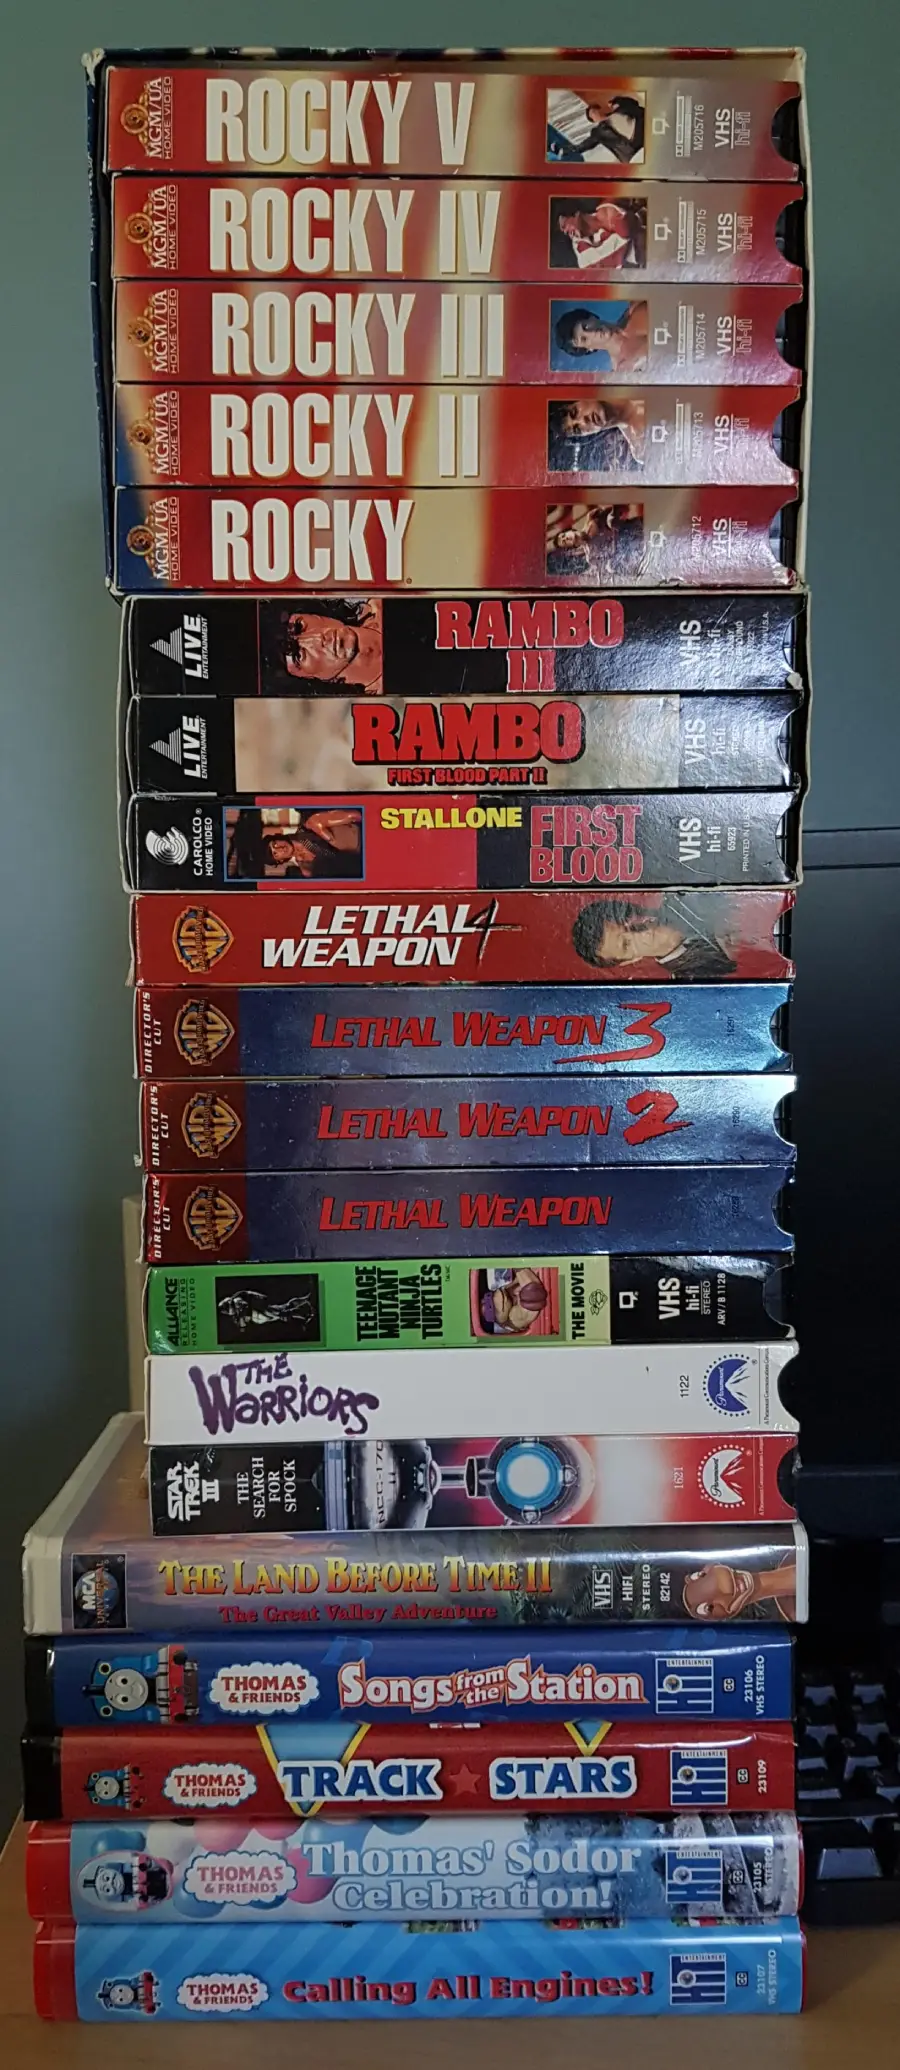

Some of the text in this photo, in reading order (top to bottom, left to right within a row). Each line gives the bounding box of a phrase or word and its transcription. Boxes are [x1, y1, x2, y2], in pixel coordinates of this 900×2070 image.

[147, 77, 162, 158] MGM/UA
[164, 76, 173, 159] HOME VIDEO
[206, 78, 475, 165] ROCKY V
[694, 104, 705, 151] M205716
[715, 108, 730, 148] VHS
[152, 186, 167, 268] MGM/UA
[168, 184, 179, 270] HOME VIDEO
[209, 187, 501, 274] ROCKY IV
[696, 209, 707, 256] M205715
[717, 212, 733, 252] VHS
[152, 289, 168, 372] MGM/UA
[168, 288, 179, 373] HOME VIDEO
[212, 291, 504, 378] ROCKY III
[717, 316, 732, 356] VHS
[154, 392, 168, 475] MGM/UA
[170, 391, 179, 476] HOME VIDEO
[211, 392, 480, 478] ROCKY II
[714, 415, 730, 455] VHS
[155, 498, 168, 580] MGM/UA
[170, 496, 179, 580] HOME VIDEO
[212, 498, 415, 583] ROCKY
[712, 519, 728, 558] VHS
[434, 599, 624, 650] RAMBO
[680, 620, 702, 666] VHS
[184, 615, 202, 678] LIVE
[506, 649, 556, 692] III
[183, 715, 201, 778] LIVE
[350, 701, 586, 765] RAMBO
[684, 718, 706, 764] VHS
[387, 767, 548, 786] FIRST BLOOD PART II
[381, 807, 522, 829] STALLONE
[530, 805, 643, 846] FIRST
[193, 817, 203, 876] CAROLCO
[205, 817, 213, 876] HOME VIDEO
[679, 817, 702, 862] VHS
[707, 826, 721, 853] hi-fi
[727, 827, 736, 852] 65923
[742, 829, 750, 872] PRINTED IN
[530, 847, 644, 884] BLOOD
[304, 904, 480, 936] LETHAL
[263, 936, 463, 968] WEAPON
[143, 992, 153, 1074] DIRECTOR'S
[154, 1020, 162, 1045] CUT
[310, 1002, 671, 1064] LETHAL WEAPON 3
[150, 1085, 160, 1166] DIRECTOR'S
[161, 1113, 169, 1138] CUT
[317, 1088, 694, 1146] LETHAL WEAPON 2
[152, 1179, 162, 1259] DIRECTOR'S
[320, 1193, 612, 1231] LETHAL WEAPON
[355, 1265, 378, 1342] TEENAGE
[377, 1267, 400, 1339] MUTANT
[399, 1275, 422, 1329] NINJA
[421, 1264, 443, 1340] TURTLES
[571, 1263, 585, 1341] THE MOVIE
[658, 1277, 680, 1319] VHS
[685, 1285, 700, 1311] hi-fi
[703, 1281, 711, 1315] STEREO
[717, 1273, 726, 1294] 1128
[165, 1277, 178, 1346] ALLIANCE
[240, 1352, 292, 1384] THE
[680, 1375, 689, 1398] 1122
[714, 1366, 727, 1406] Paramount
[167, 1461, 184, 1521] STAR
[184, 1461, 201, 1521] TREK
[202, 1479, 219, 1502] III
[237, 1472, 249, 1504] THE
[252, 1457, 265, 1519] SEARCH
[268, 1470, 280, 1502] FOR
[283, 1459, 296, 1512] SPOCK
[674, 1467, 683, 1489] 1621
[710, 1457, 723, 1497] Paramount
[82, 1573, 96, 1610] MCA
[160, 1556, 553, 1596] THE LAND BEFORE TIME II
[594, 1571, 611, 1607] VHS
[622, 1576, 633, 1601] HIFI
[642, 1564, 650, 1611] STEREO
[660, 1572, 670, 1602] 82142
[220, 1601, 498, 1622] The Great Valley Adventure
[221, 1675, 306, 1691] THOMAS
[229, 1692, 301, 1703] & FRIENDS
[340, 1658, 643, 1711] Songs from Station
[466, 1686, 500, 1707] the
[744, 1669, 753, 1703] 23106
[756, 1655, 764, 1715] VHS STEREO
[174, 1774, 246, 1787] THOMAS
[180, 1788, 241, 1797] & FRIENDS
[281, 1761, 633, 1799] TRACK STARS
[757, 1760, 766, 1794] 23109
[197, 1866, 283, 1881] THOMAS
[304, 1840, 642, 1877] Thomas' Sodor
[753, 1862, 762, 1893] 23105
[205, 1883, 278, 1893] & FRIENDS
[333, 1880, 613, 1911] Celebration!
[757, 1965, 765, 1994] 23107
[768, 1949, 777, 1984] STEREO
[186, 1983, 258, 1996] THOMAS
[193, 1996, 254, 2004] & FRIENDS
[283, 1971, 654, 2005] Calling All Engines!
